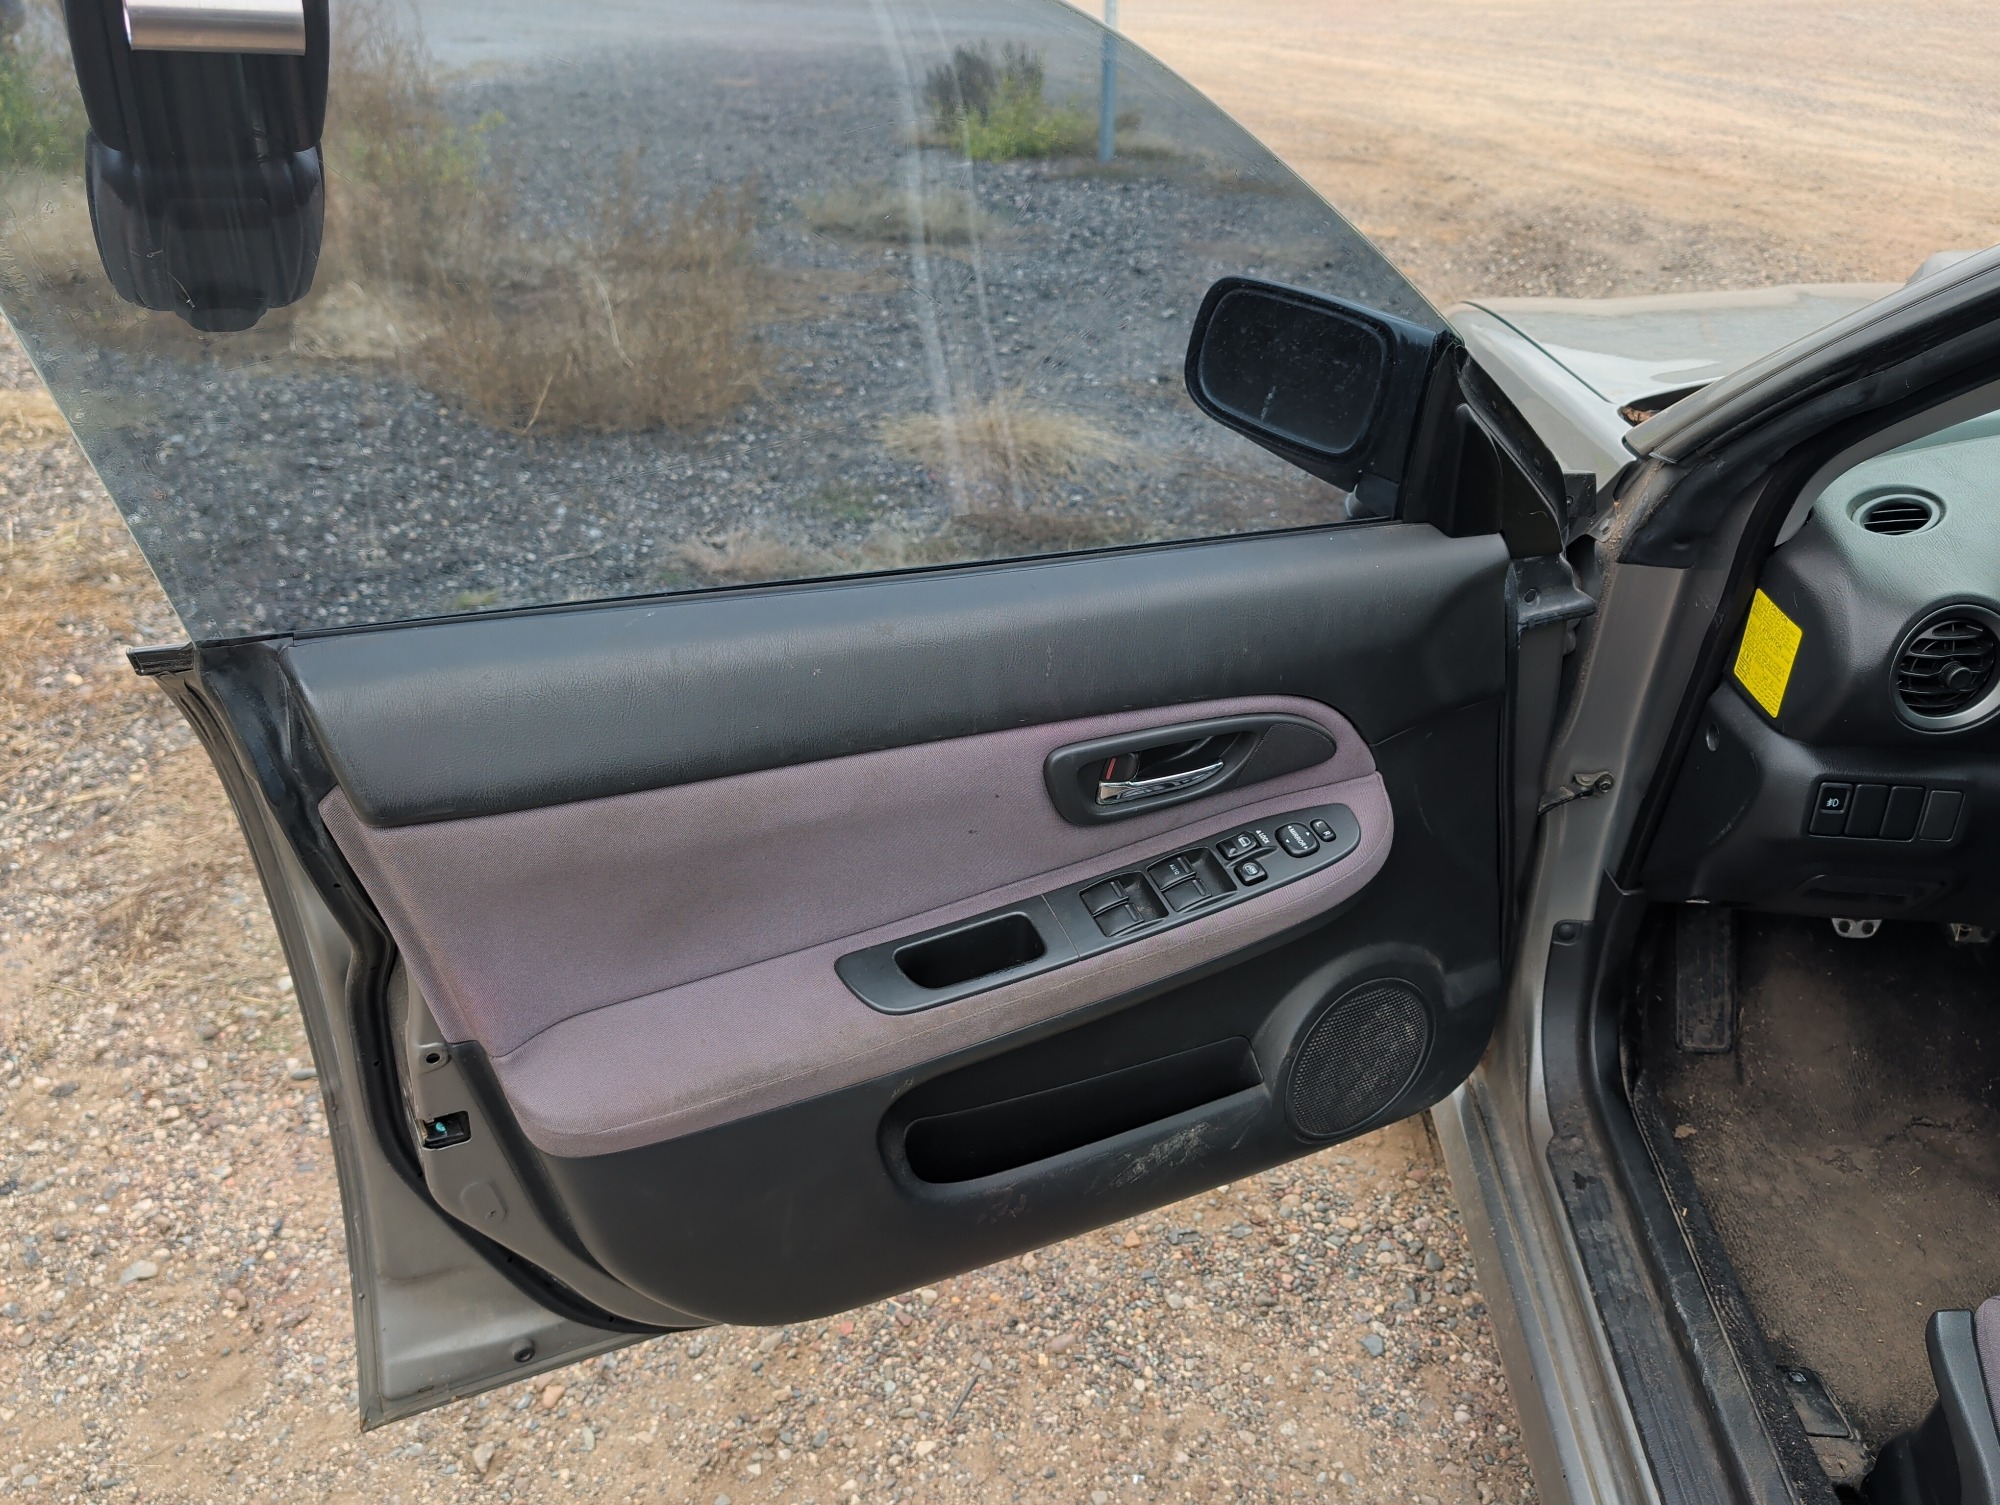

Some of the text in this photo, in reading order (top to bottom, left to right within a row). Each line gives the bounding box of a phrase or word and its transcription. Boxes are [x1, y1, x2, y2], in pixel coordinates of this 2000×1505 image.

[1259, 832, 1270, 844] LOCK
[1289, 827, 1307, 847] MIRROR
[1169, 863, 1180, 875] AUTO
